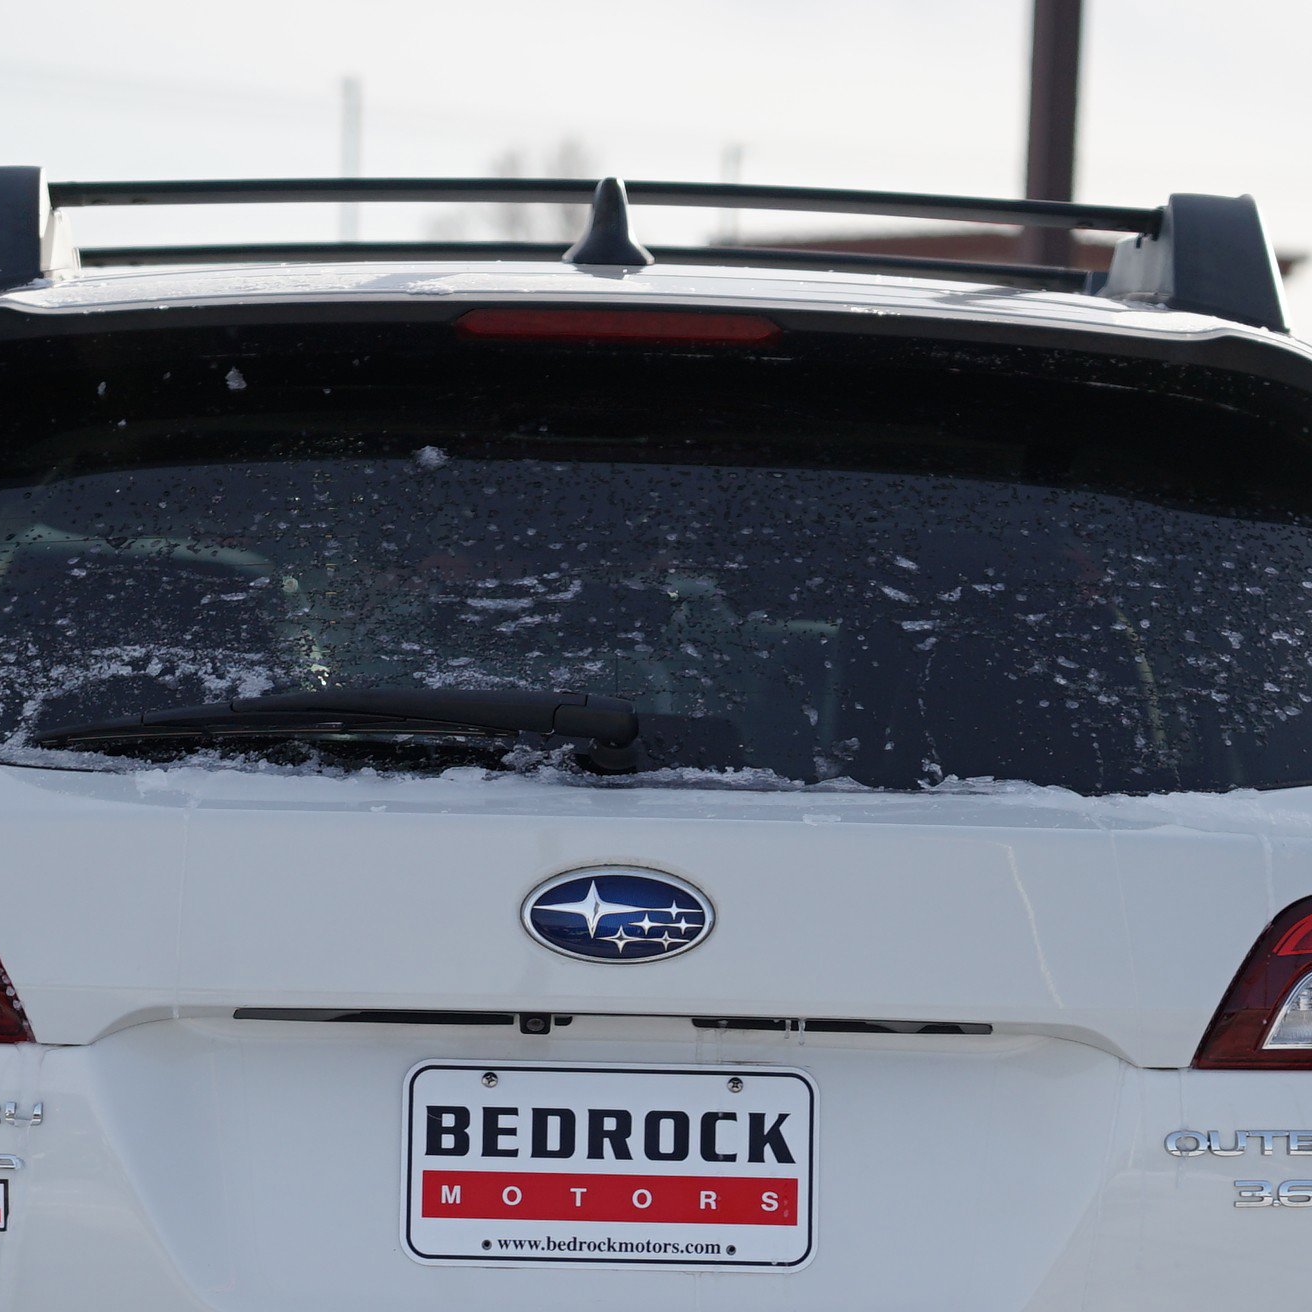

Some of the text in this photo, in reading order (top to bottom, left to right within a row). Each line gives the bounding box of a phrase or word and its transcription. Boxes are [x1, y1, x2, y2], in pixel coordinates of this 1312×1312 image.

[424, 1105, 797, 1165] BEDROCK
[440, 1184, 780, 1213] MOTORS
[497, 1235, 722, 1256] www.bedrockmotors.com
